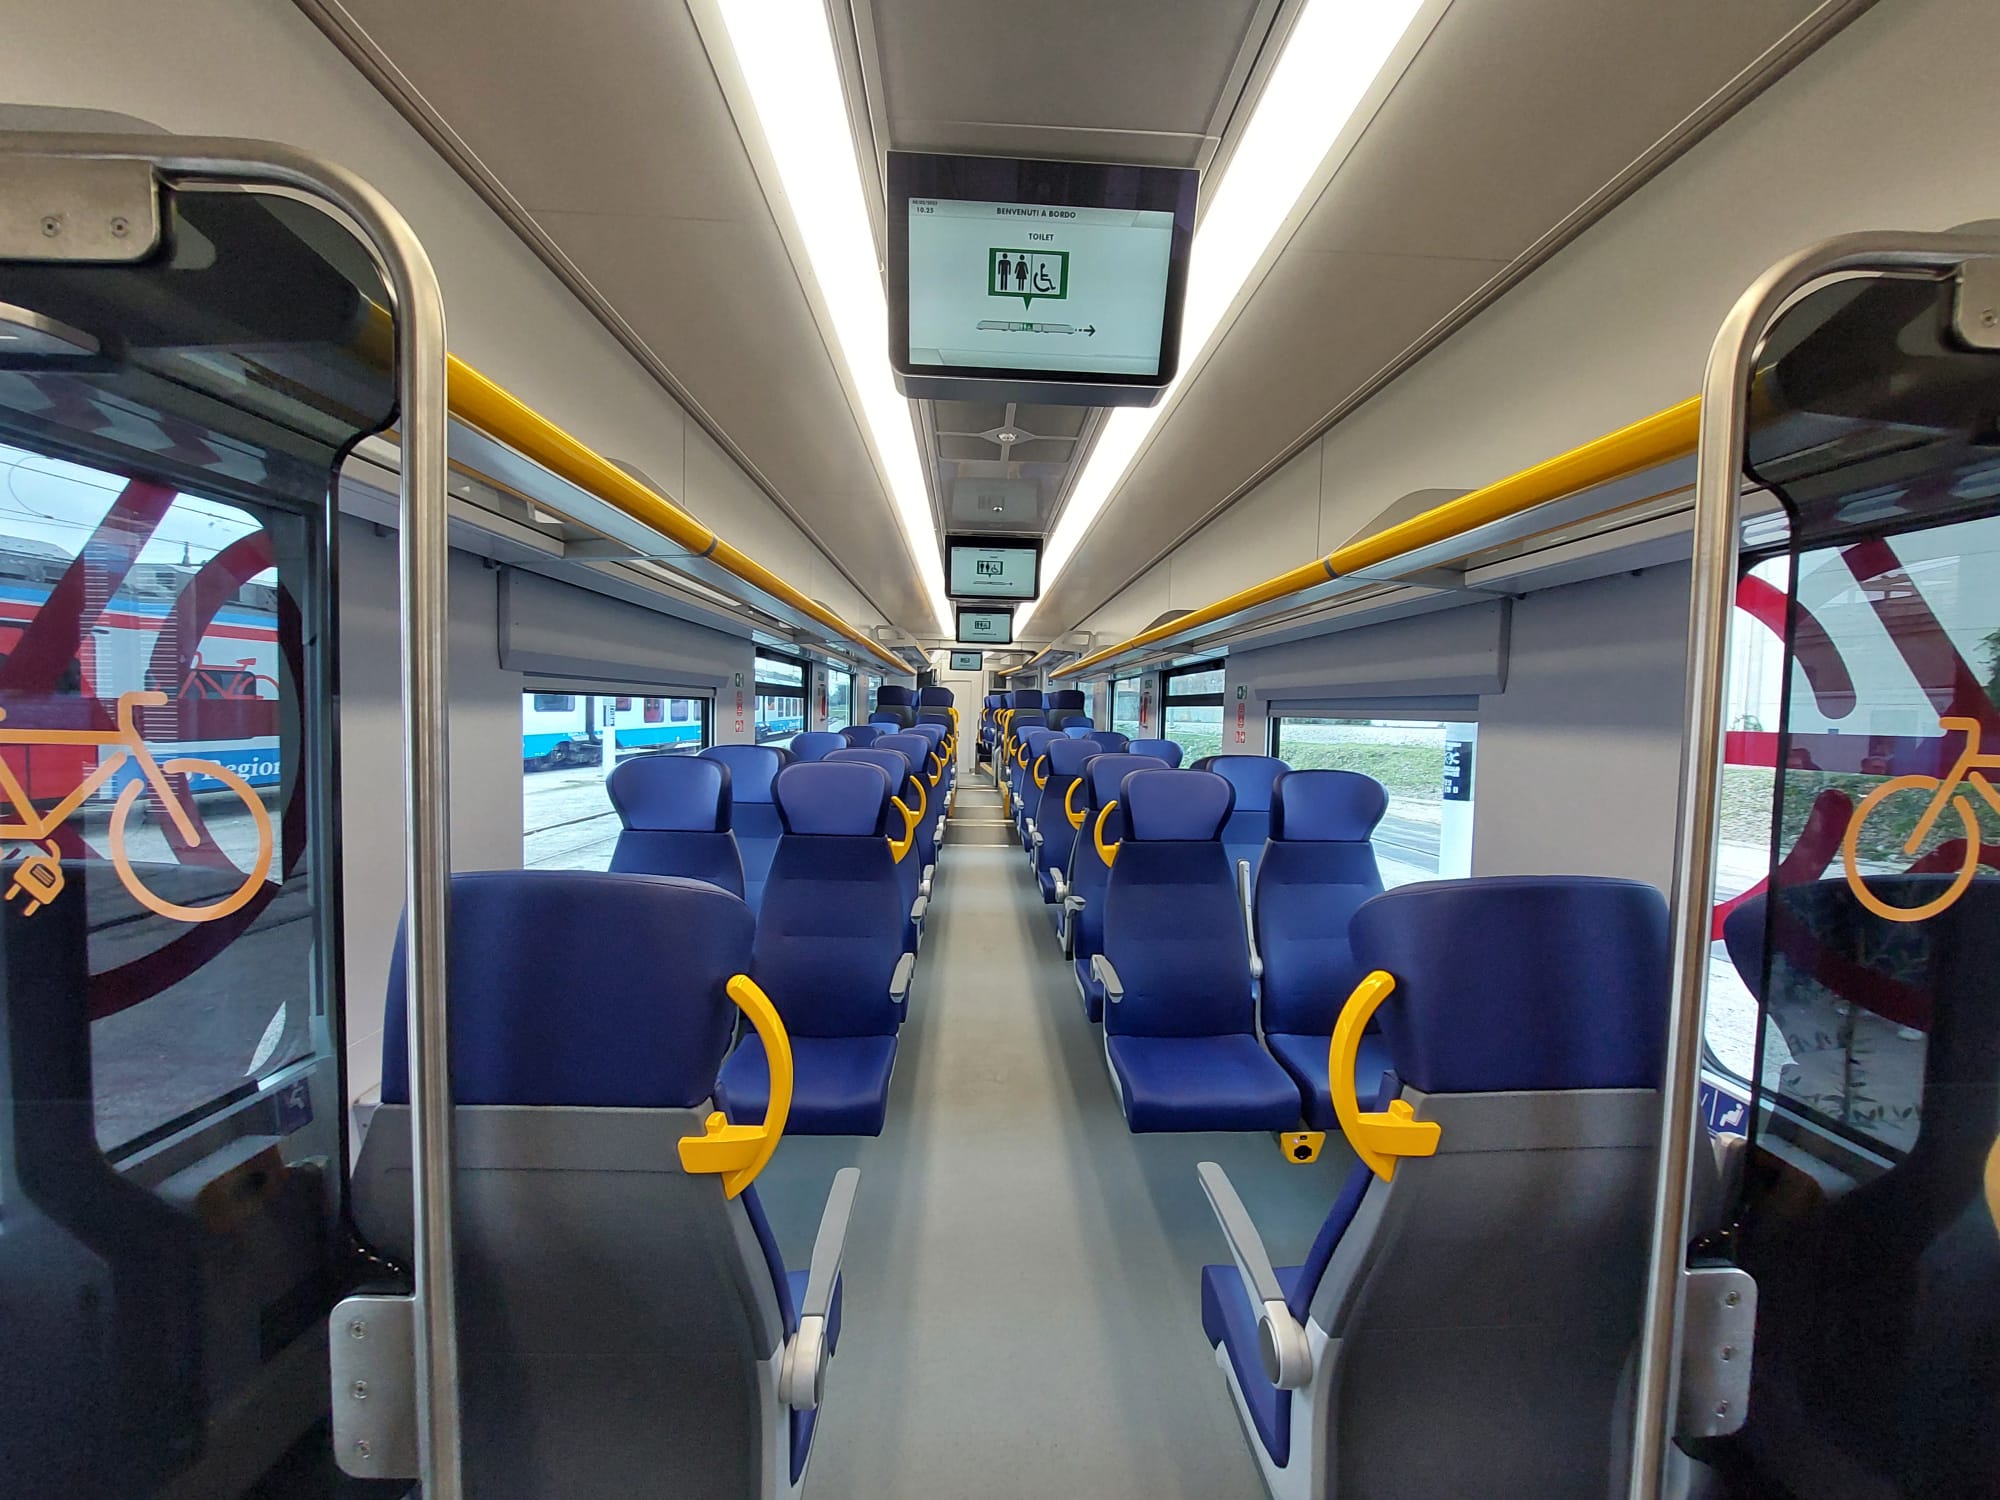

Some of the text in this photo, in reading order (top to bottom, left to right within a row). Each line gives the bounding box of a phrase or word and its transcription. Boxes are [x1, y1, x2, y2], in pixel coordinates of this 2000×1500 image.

[996, 207, 1040, 217] BENVENUTI
[1048, 210, 1076, 219] BORDO
[1028, 232, 1054, 241] TOILET
